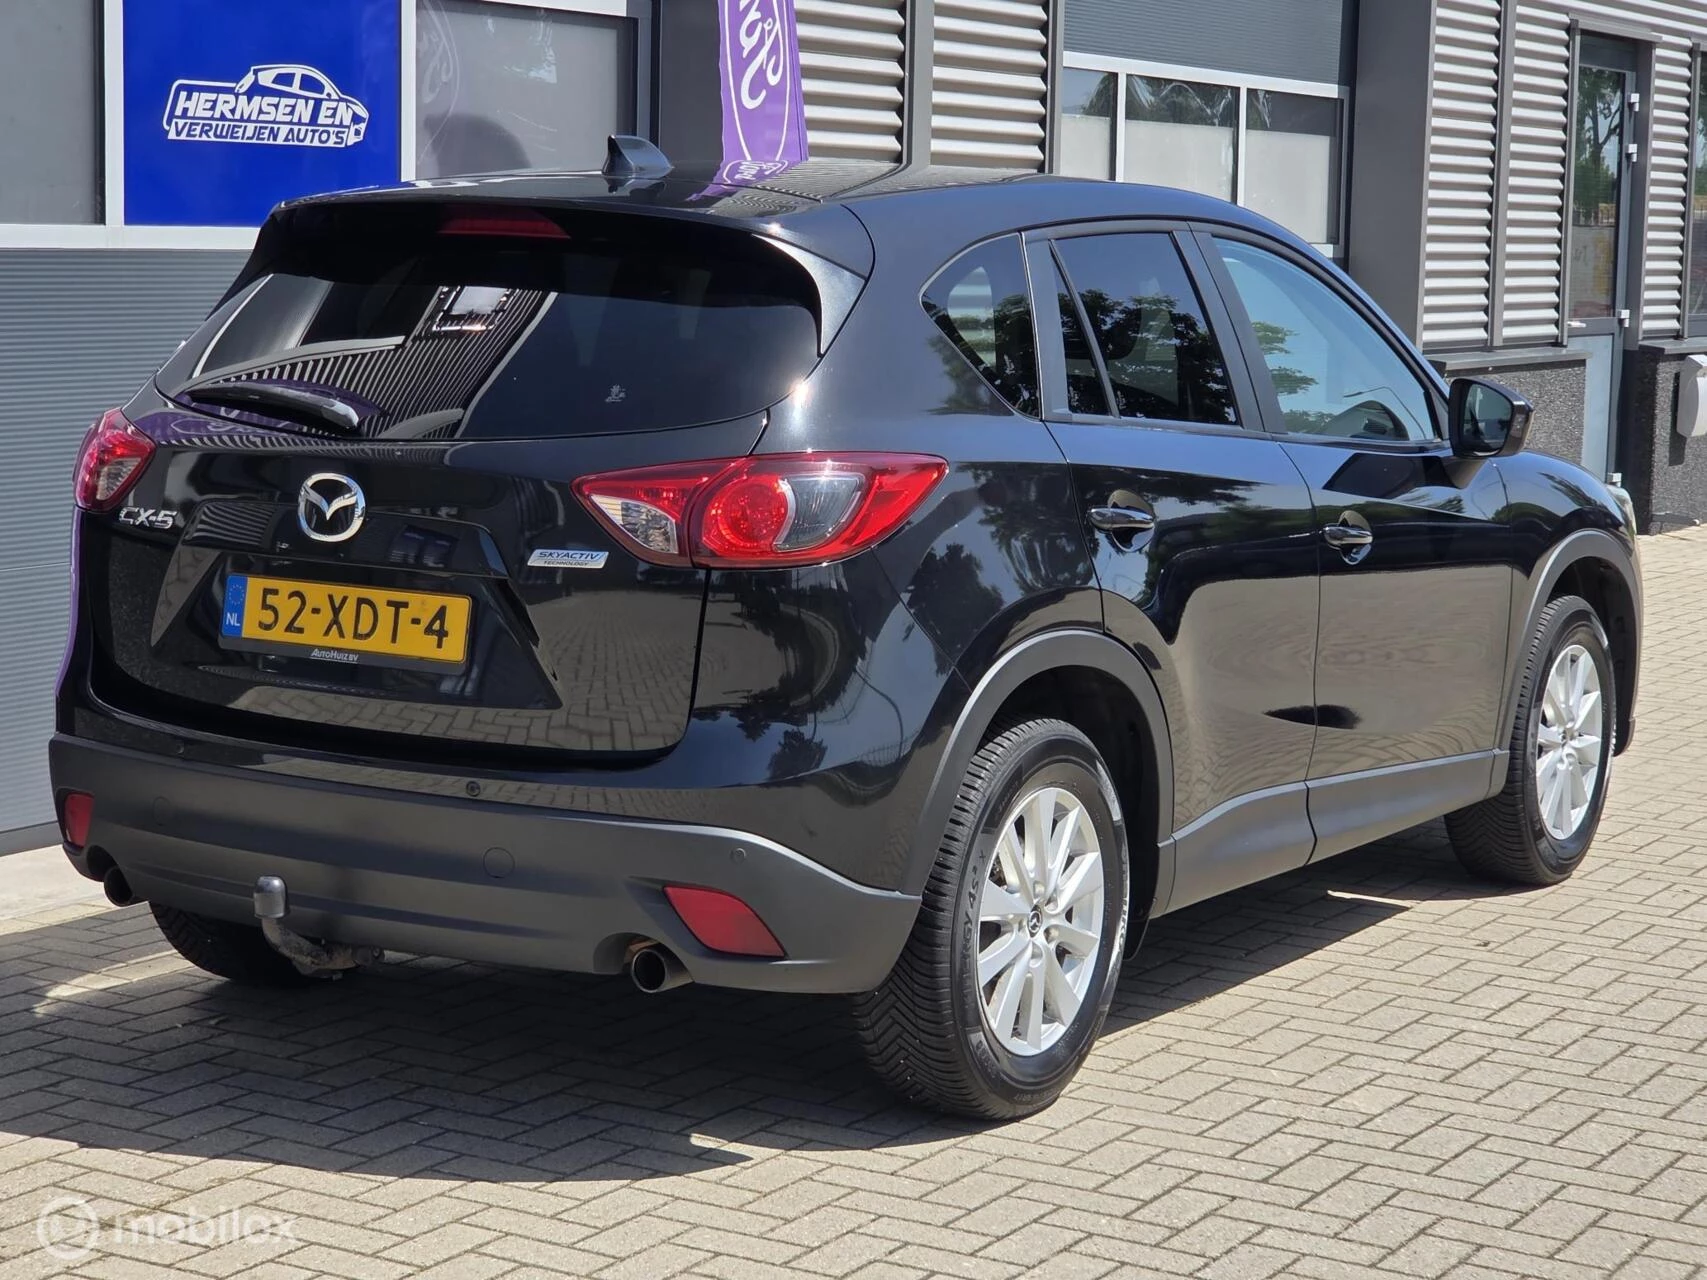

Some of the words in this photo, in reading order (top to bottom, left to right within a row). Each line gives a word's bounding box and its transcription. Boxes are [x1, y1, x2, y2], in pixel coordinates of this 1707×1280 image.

[174, 91, 315, 123] HERMSEN
[317, 101, 353, 126] EN
[175, 121, 281, 142] VERWEIJEN
[283, 127, 347, 146] AUTO'S
[119, 506, 178, 529] CX-5
[538, 551, 600, 560] SKYACTIV
[225, 611, 241, 627] NL
[257, 587, 449, 649] 52-XDT-4
